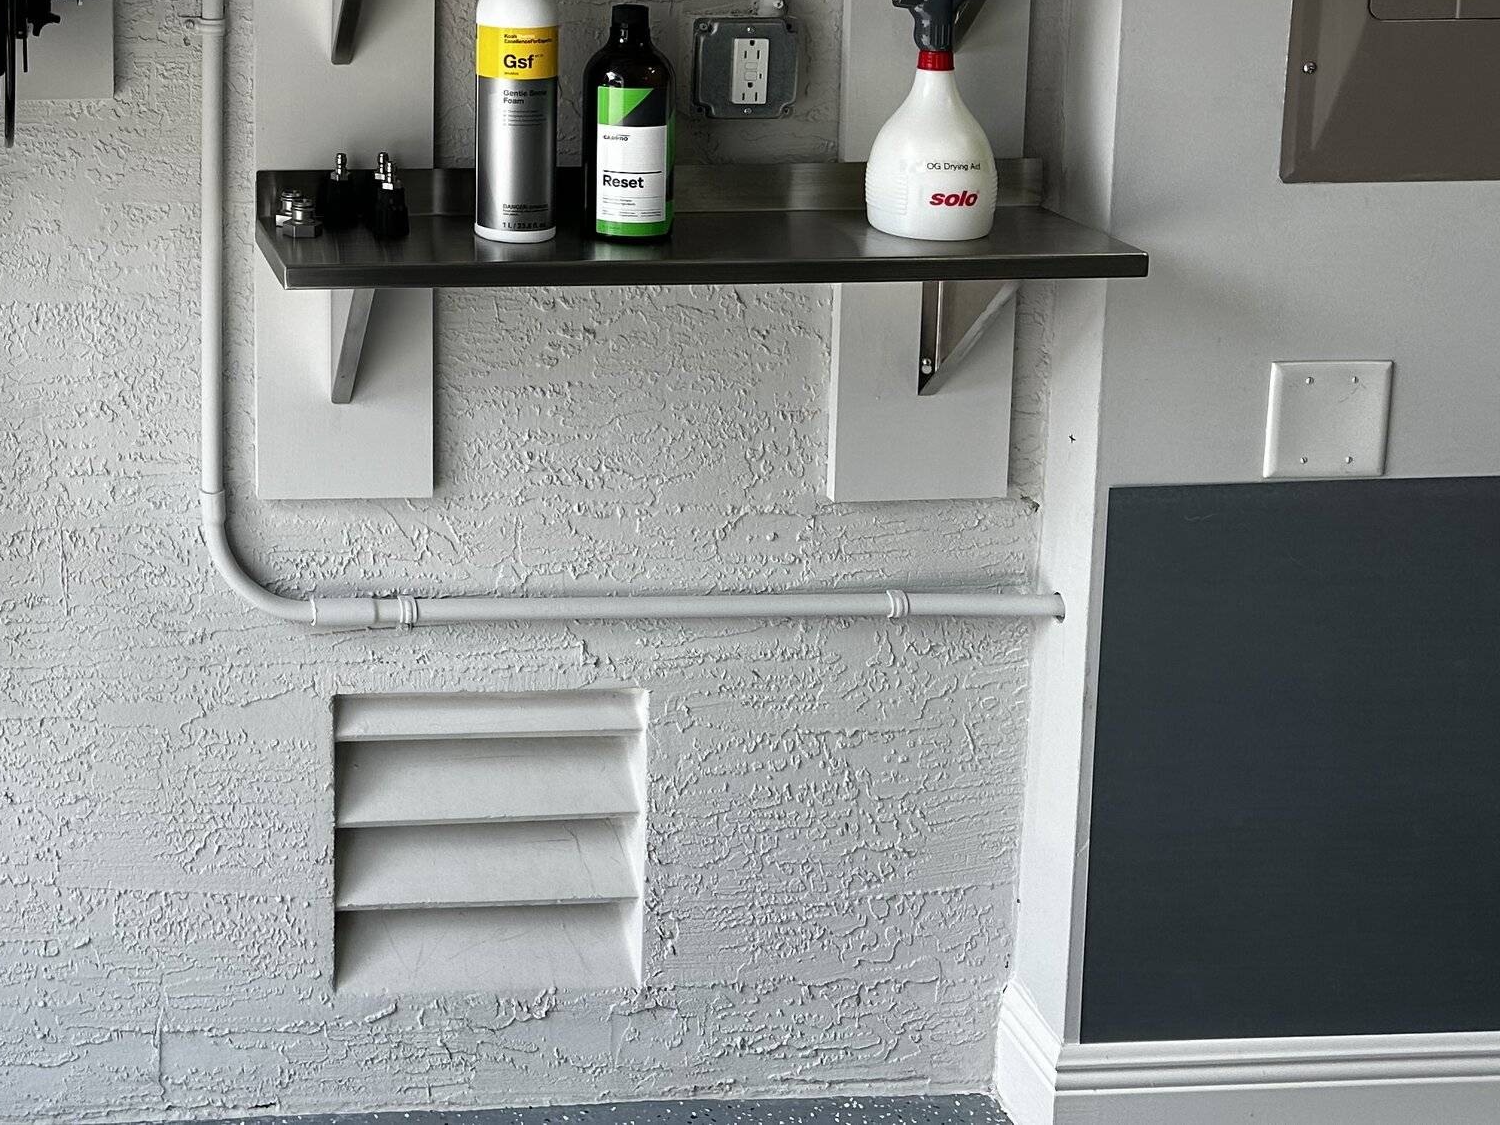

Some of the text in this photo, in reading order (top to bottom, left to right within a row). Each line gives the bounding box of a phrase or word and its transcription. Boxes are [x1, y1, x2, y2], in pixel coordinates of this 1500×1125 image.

[503, 54, 535, 69] Gsf
[926, 162, 941, 170] OG
[943, 162, 969, 171] Drying
[603, 174, 644, 188] Reset
[929, 190, 979, 207] solo
